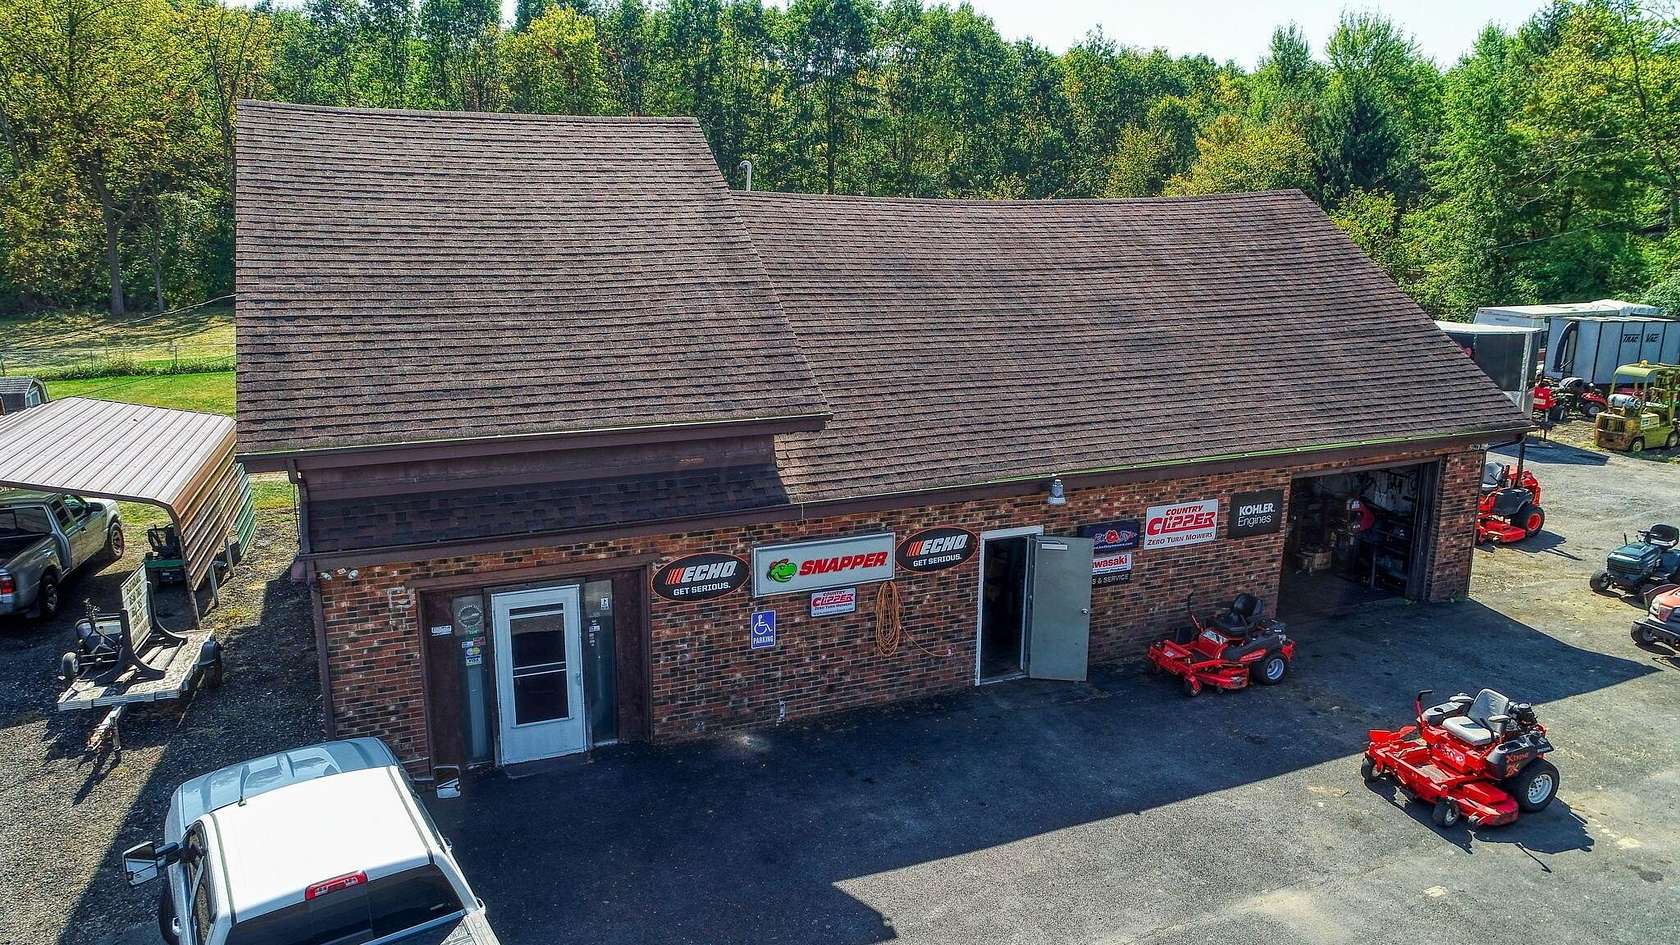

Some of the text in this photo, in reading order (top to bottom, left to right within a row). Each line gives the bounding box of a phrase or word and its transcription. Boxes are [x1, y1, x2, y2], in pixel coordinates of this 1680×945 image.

[1165, 505, 1204, 516] COUNTRY
[1237, 514, 1272, 527] Engines
[920, 534, 969, 555] ECHO
[1147, 531, 1213, 546] ZERO TURN MOWERS
[799, 551, 888, 576] SNAPPER
[913, 559, 927, 567] GET
[1093, 554, 1128, 568] wasaki
[681, 560, 738, 583] ECHO
[673, 587, 690, 596] GET
[753, 635, 774, 645] PARKING
